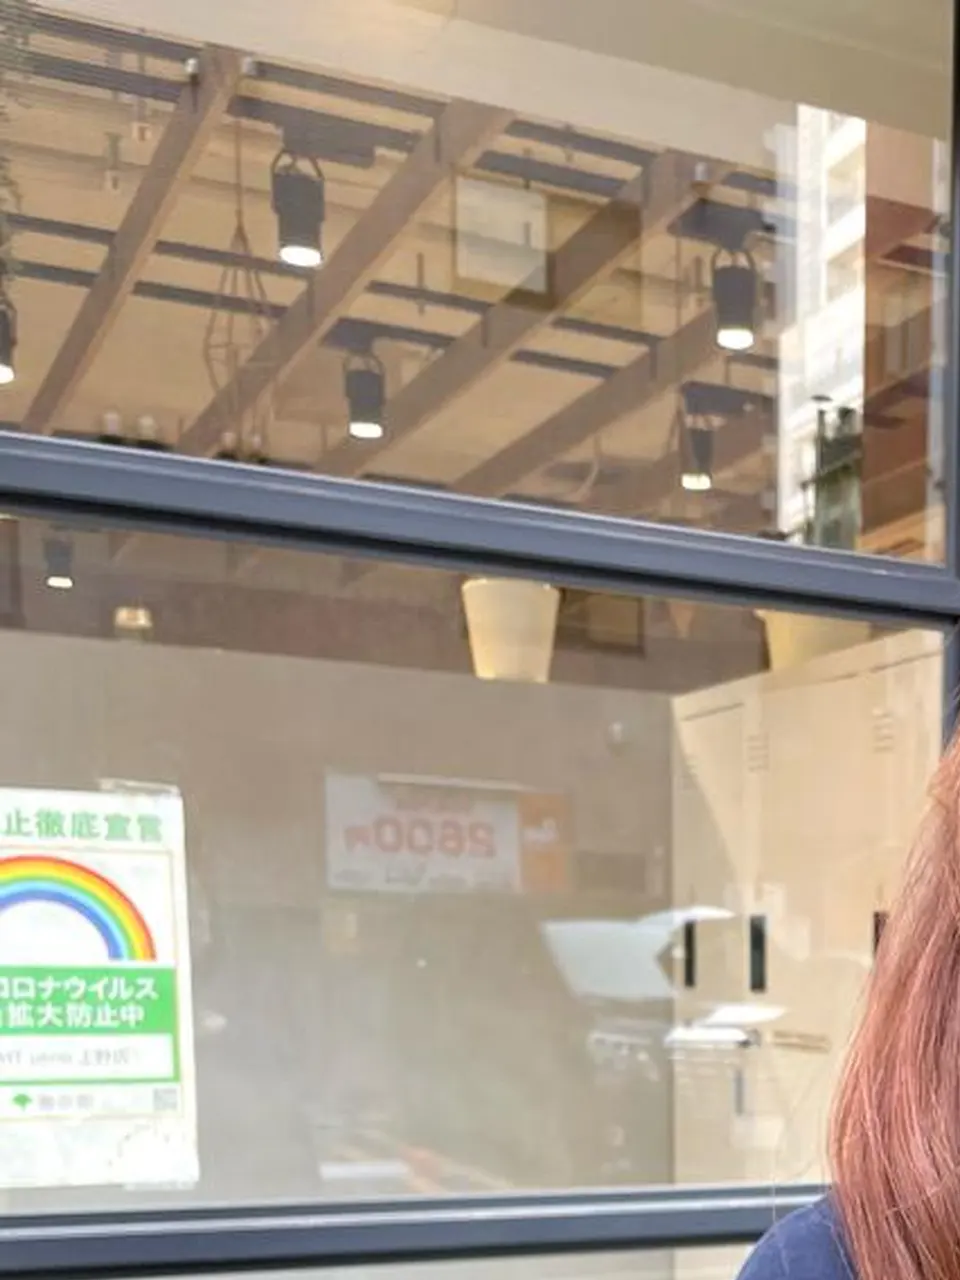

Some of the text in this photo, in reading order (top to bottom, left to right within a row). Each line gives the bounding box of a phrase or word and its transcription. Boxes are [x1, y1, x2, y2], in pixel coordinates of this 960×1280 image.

[0, 1000, 146, 1029] 拡大防止中
